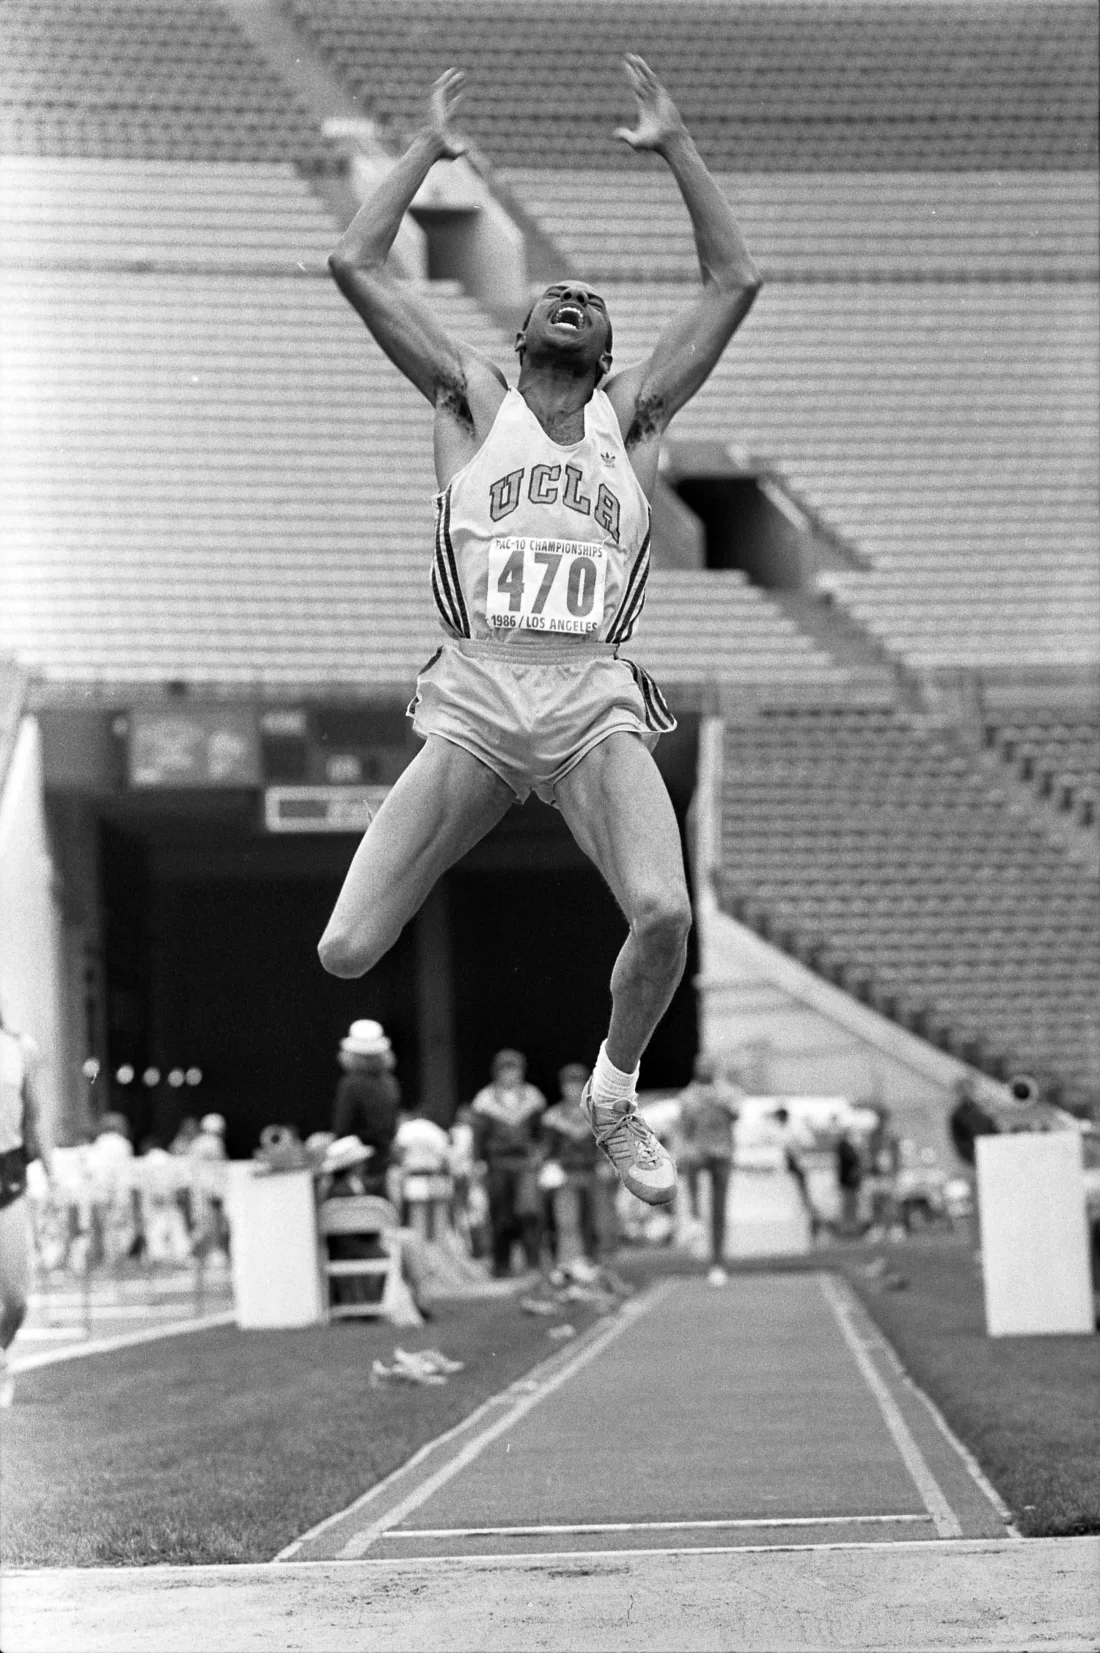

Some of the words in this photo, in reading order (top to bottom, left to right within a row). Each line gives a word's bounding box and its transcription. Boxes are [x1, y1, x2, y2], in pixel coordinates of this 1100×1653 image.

[490, 464, 621, 545] UCLA
[530, 540, 603, 558] CHAMPIONSHIPS
[497, 550, 597, 618] 470
[491, 614, 516, 627] 1986
[526, 616, 546, 629] LOS
[549, 618, 598, 633] ANGELES
